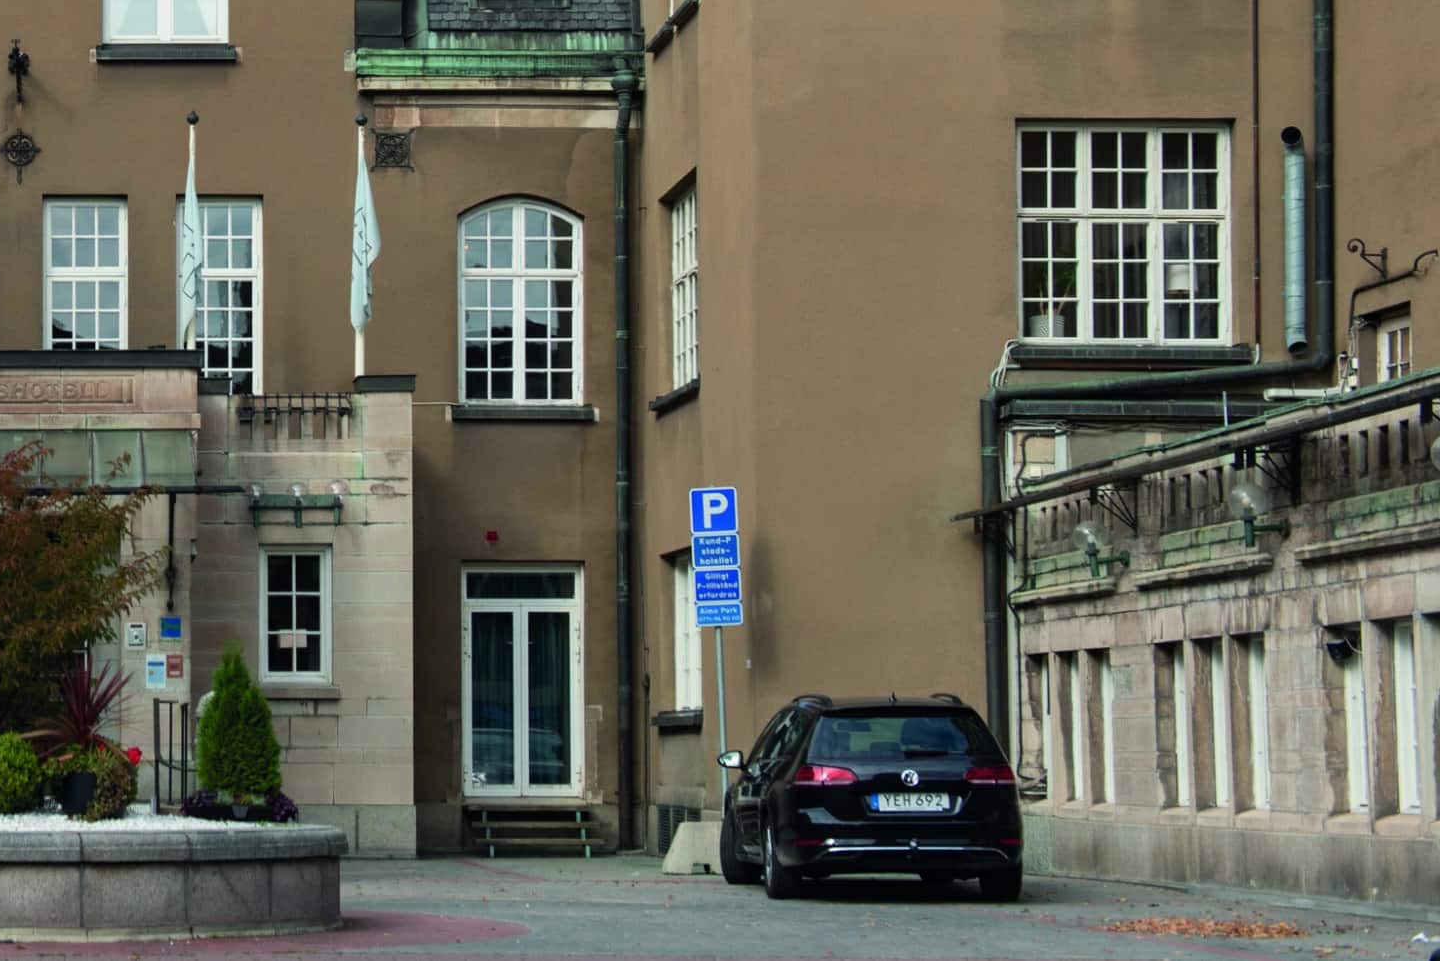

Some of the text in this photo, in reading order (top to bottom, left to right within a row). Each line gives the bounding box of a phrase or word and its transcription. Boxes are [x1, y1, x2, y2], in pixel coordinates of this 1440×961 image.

[702, 492, 728, 528] P
[884, 794, 943, 807] YEH 692
